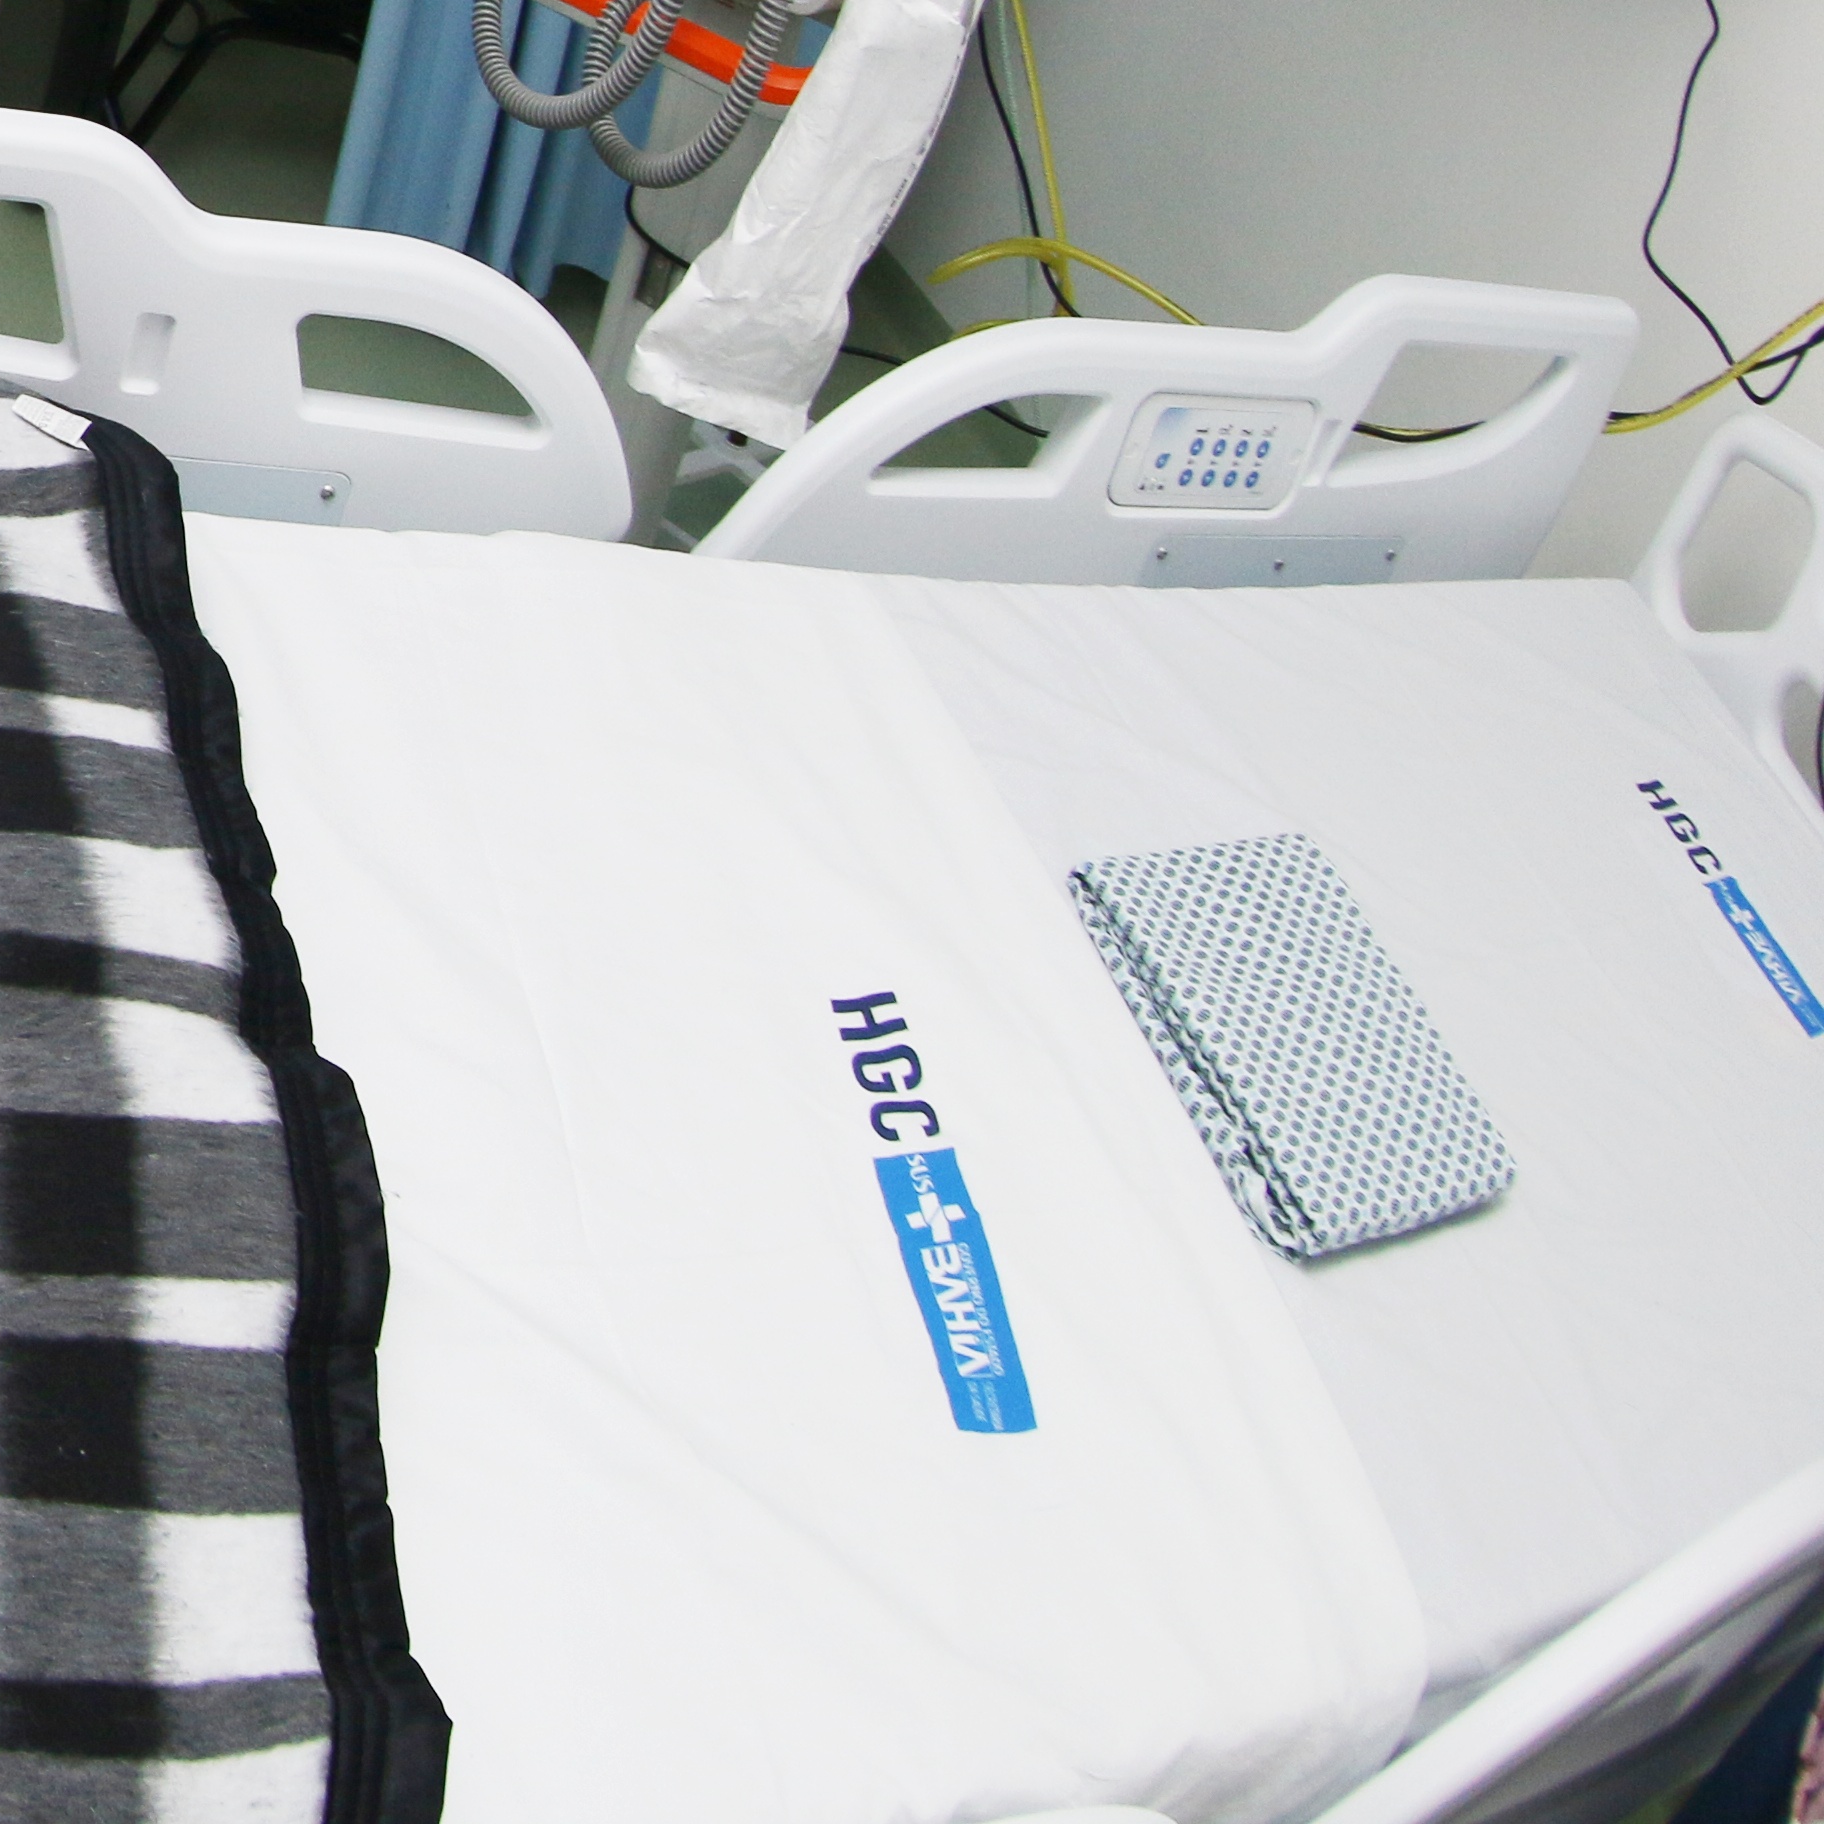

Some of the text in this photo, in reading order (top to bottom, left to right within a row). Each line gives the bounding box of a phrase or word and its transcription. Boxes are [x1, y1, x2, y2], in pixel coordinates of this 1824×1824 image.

[1636, 779, 1723, 876] HGC
[830, 990, 941, 1143] HGC
[905, 1153, 935, 1194] SUS
[920, 1244, 991, 1377] BAHIA
[956, 1242, 985, 1305] GOVERNO
[976, 1308, 991, 1326] DO
